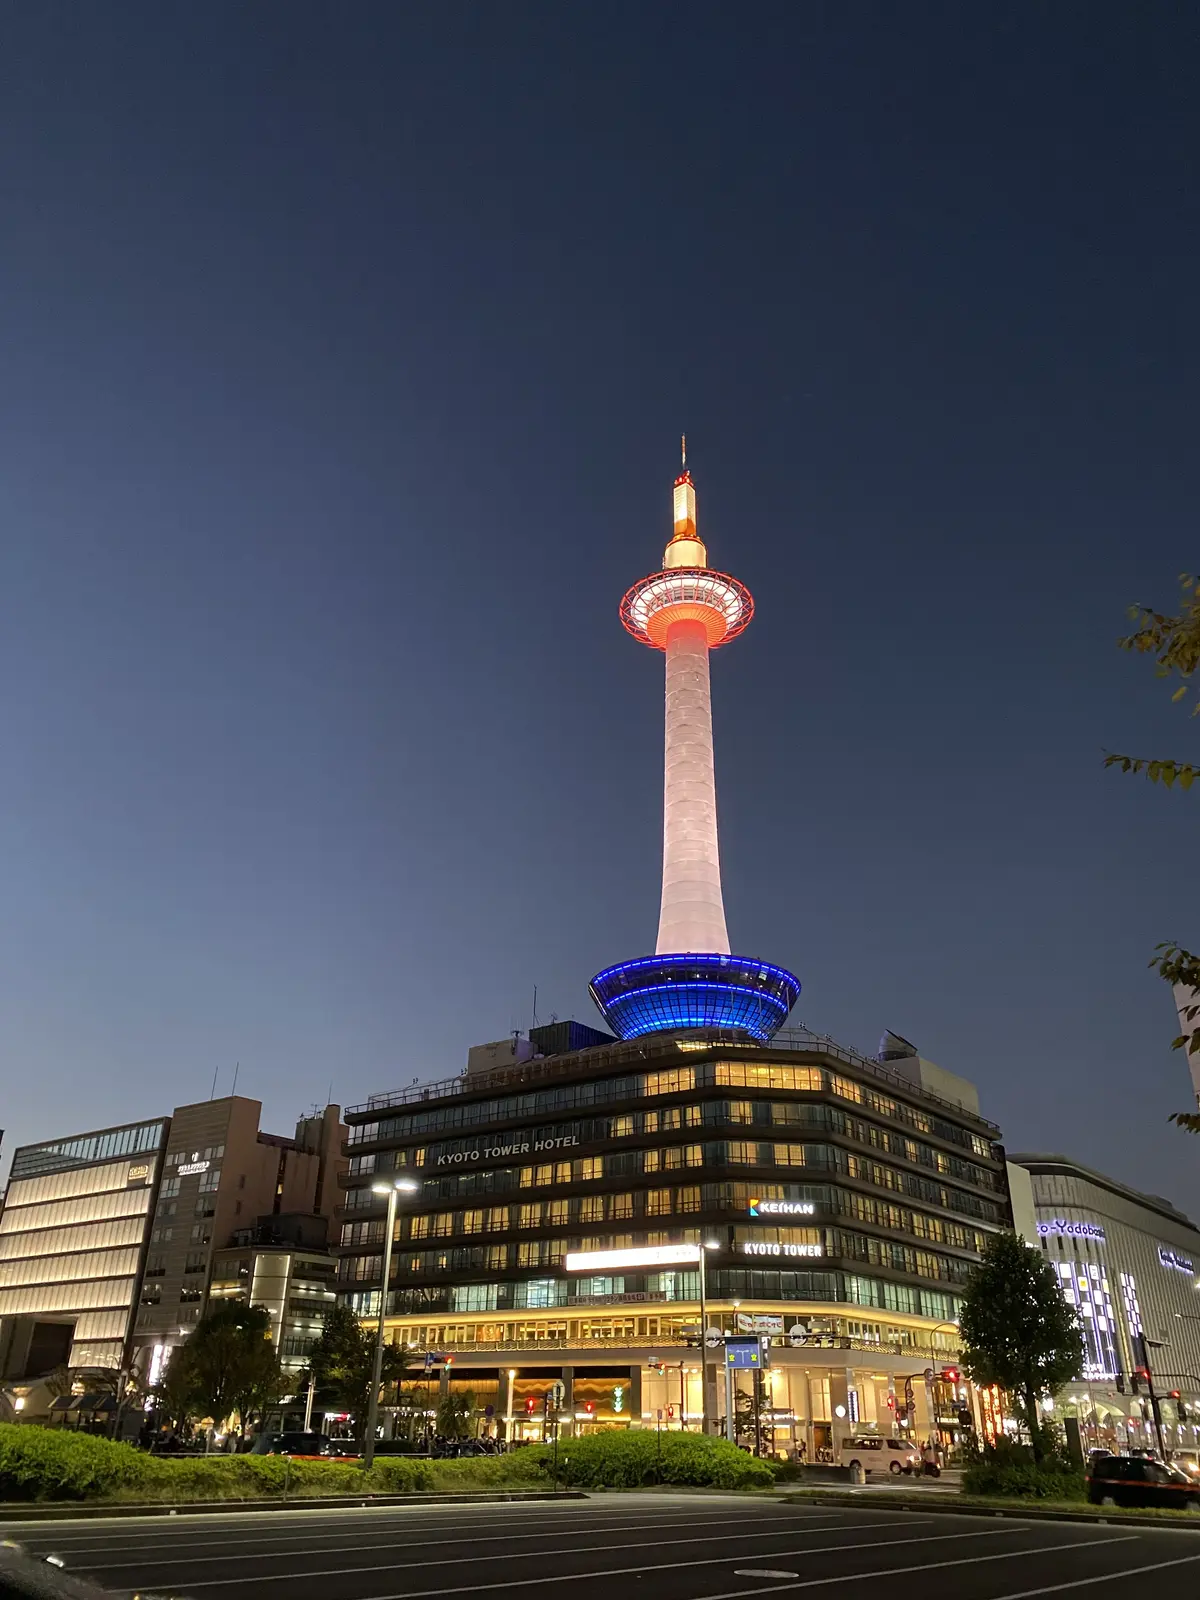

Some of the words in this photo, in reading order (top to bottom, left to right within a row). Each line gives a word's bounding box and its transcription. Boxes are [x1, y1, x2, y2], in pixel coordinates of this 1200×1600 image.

[437, 1150, 479, 1165] KYOTO
[484, 1143, 529, 1158] TOWER
[534, 1136, 579, 1151] HOTEL
[760, 1203, 814, 1214] KEIHAN
[1036, 1220, 1106, 1238] o-Yodoba
[744, 1243, 780, 1255] KYOTO
[783, 1244, 821, 1256] TOWER
